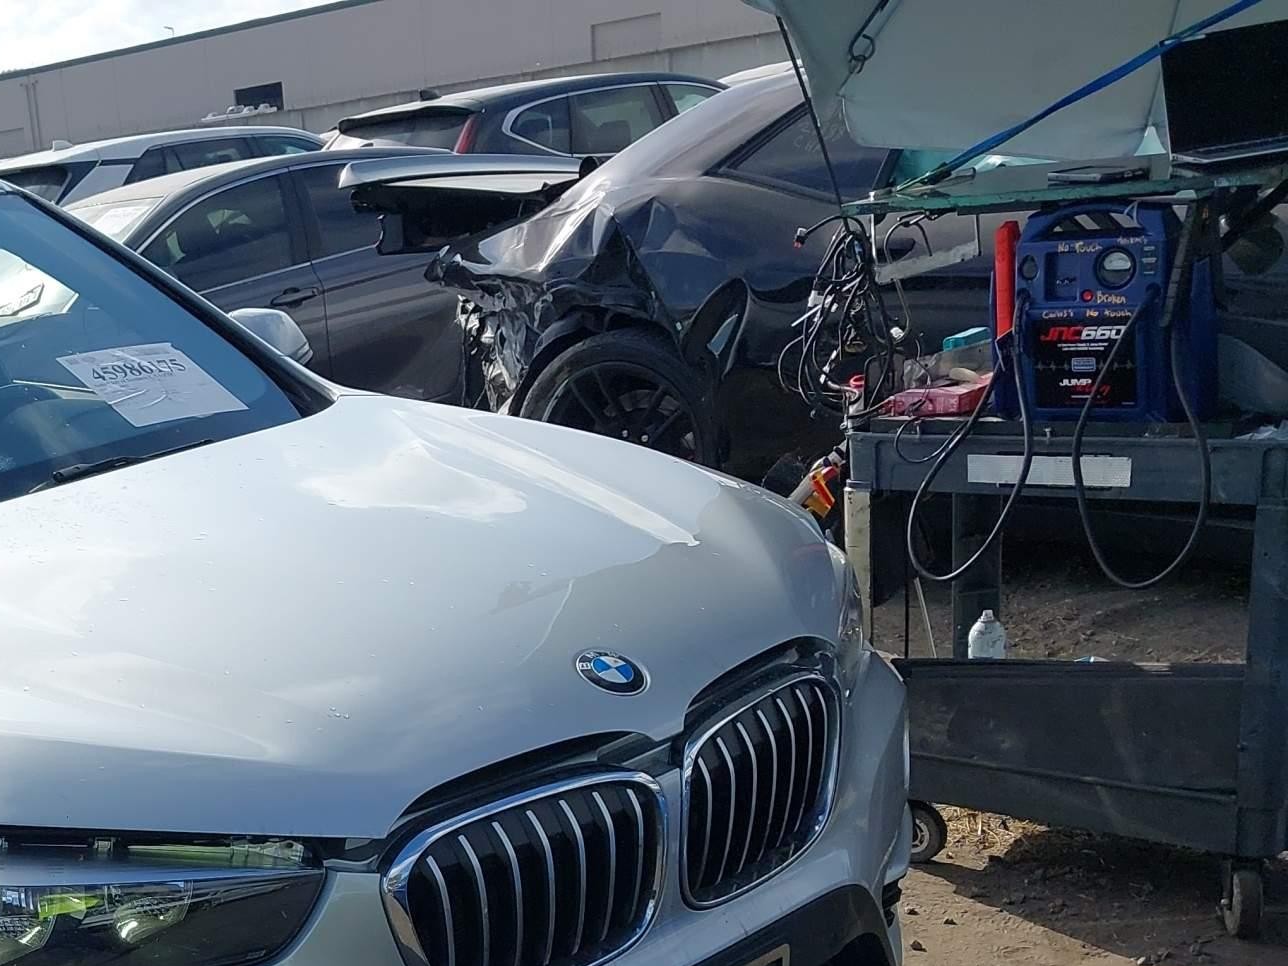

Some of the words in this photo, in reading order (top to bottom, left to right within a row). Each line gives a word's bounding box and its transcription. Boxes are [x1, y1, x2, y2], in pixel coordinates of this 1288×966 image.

[1040, 325, 1127, 341] JNC660
[92, 359, 186, 381] 45986175
[1058, 377, 1093, 387] JUMP
